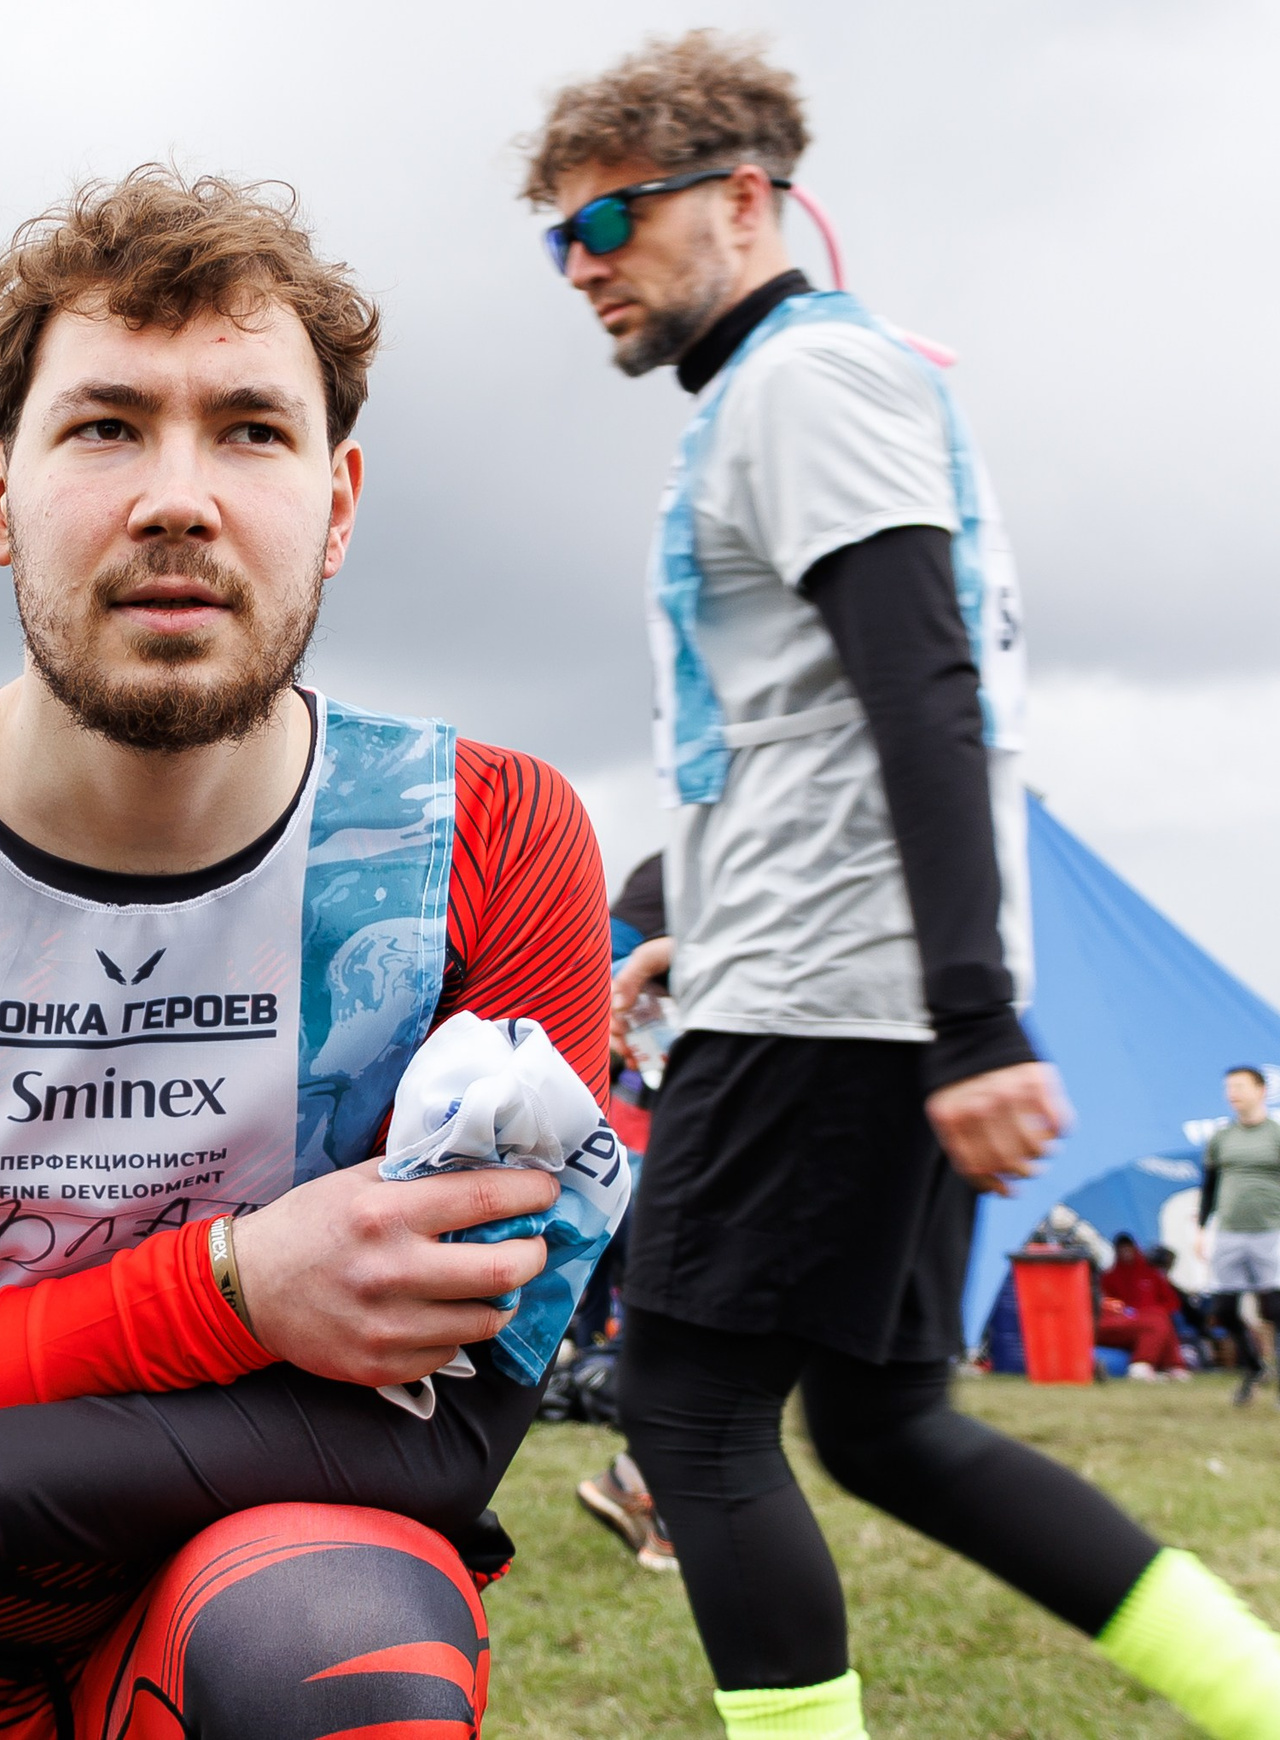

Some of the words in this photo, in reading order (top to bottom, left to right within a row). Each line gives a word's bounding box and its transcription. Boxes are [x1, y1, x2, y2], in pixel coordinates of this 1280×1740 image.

[121, 992, 278, 1034] ГЕРОЕВ
[6, 1066, 227, 1123] Sminex
[0, 1147, 228, 1173] ПЕРФЕКЦИОНИСТЫ
[60, 1170, 225, 1201] DEVELOPMENT
